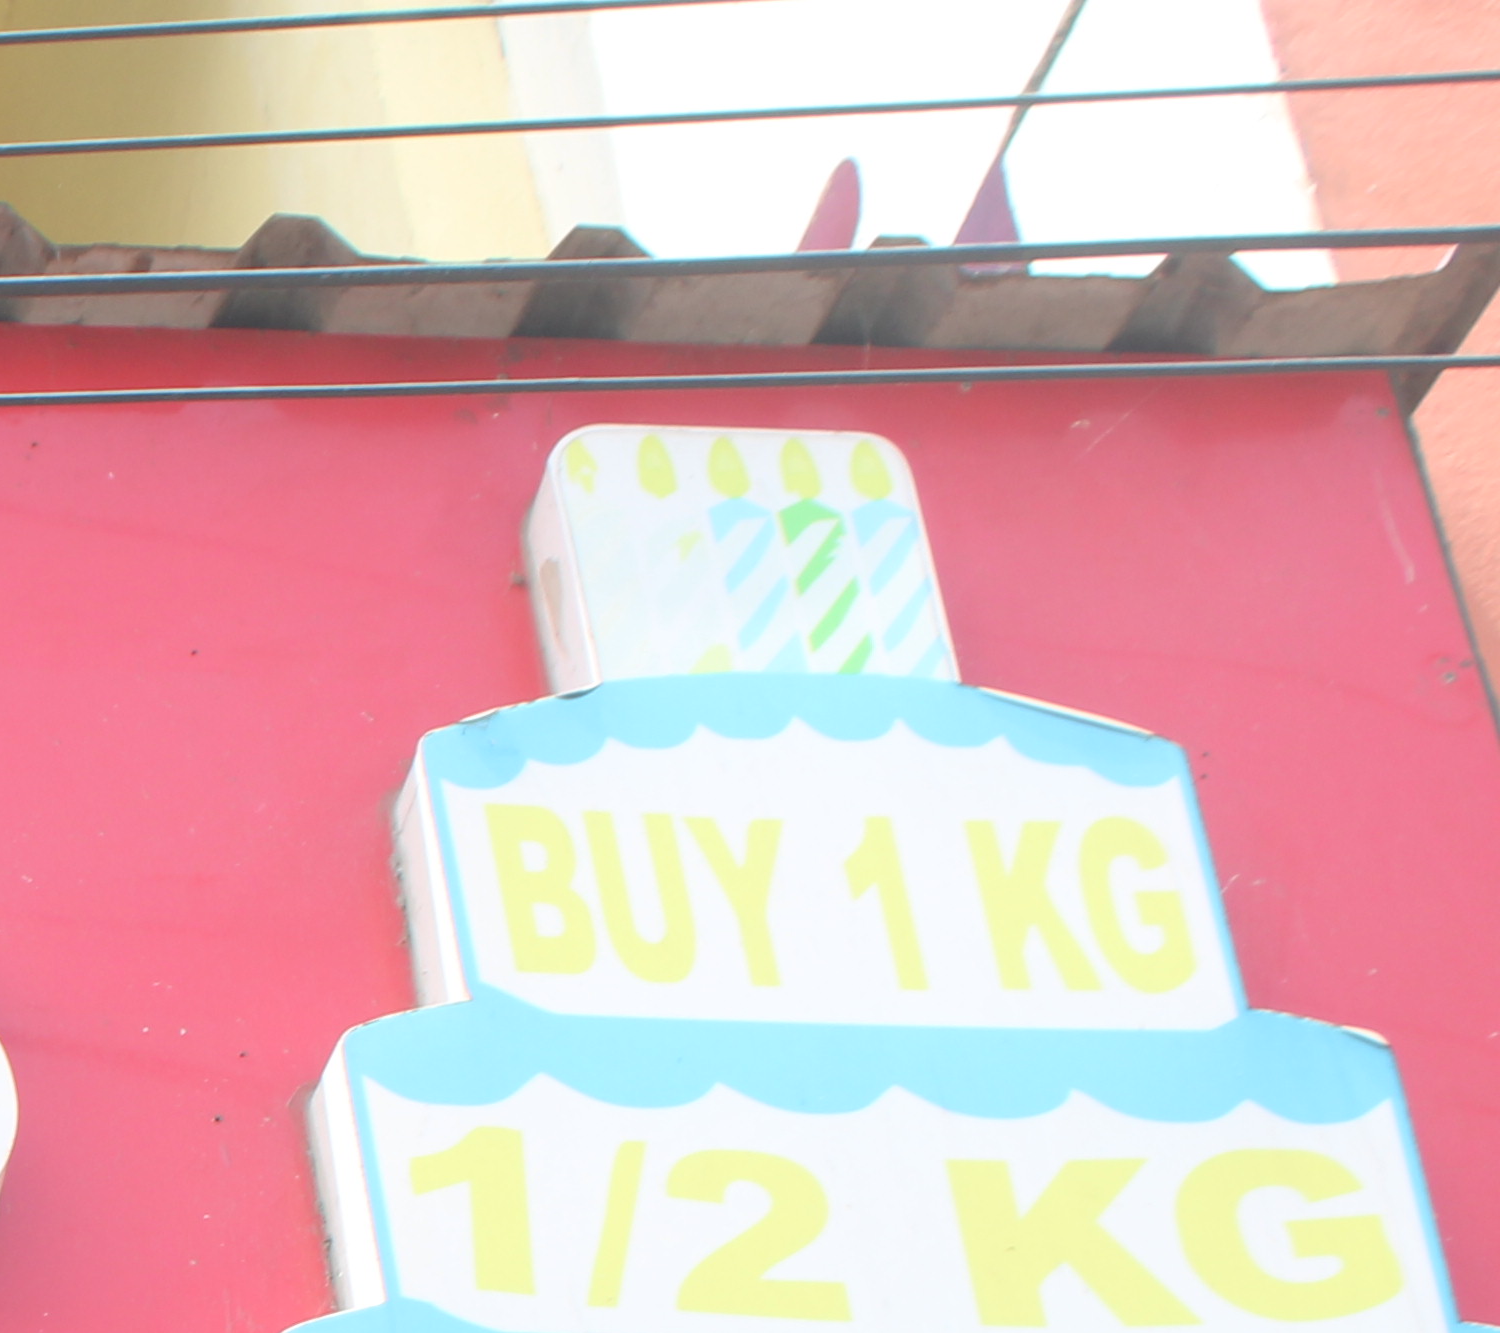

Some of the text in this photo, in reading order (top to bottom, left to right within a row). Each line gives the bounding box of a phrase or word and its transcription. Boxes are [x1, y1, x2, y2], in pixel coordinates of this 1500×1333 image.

[485, 802, 1200, 995] BUY 1 KG
[409, 1125, 1404, 1329] 1/2 KG
